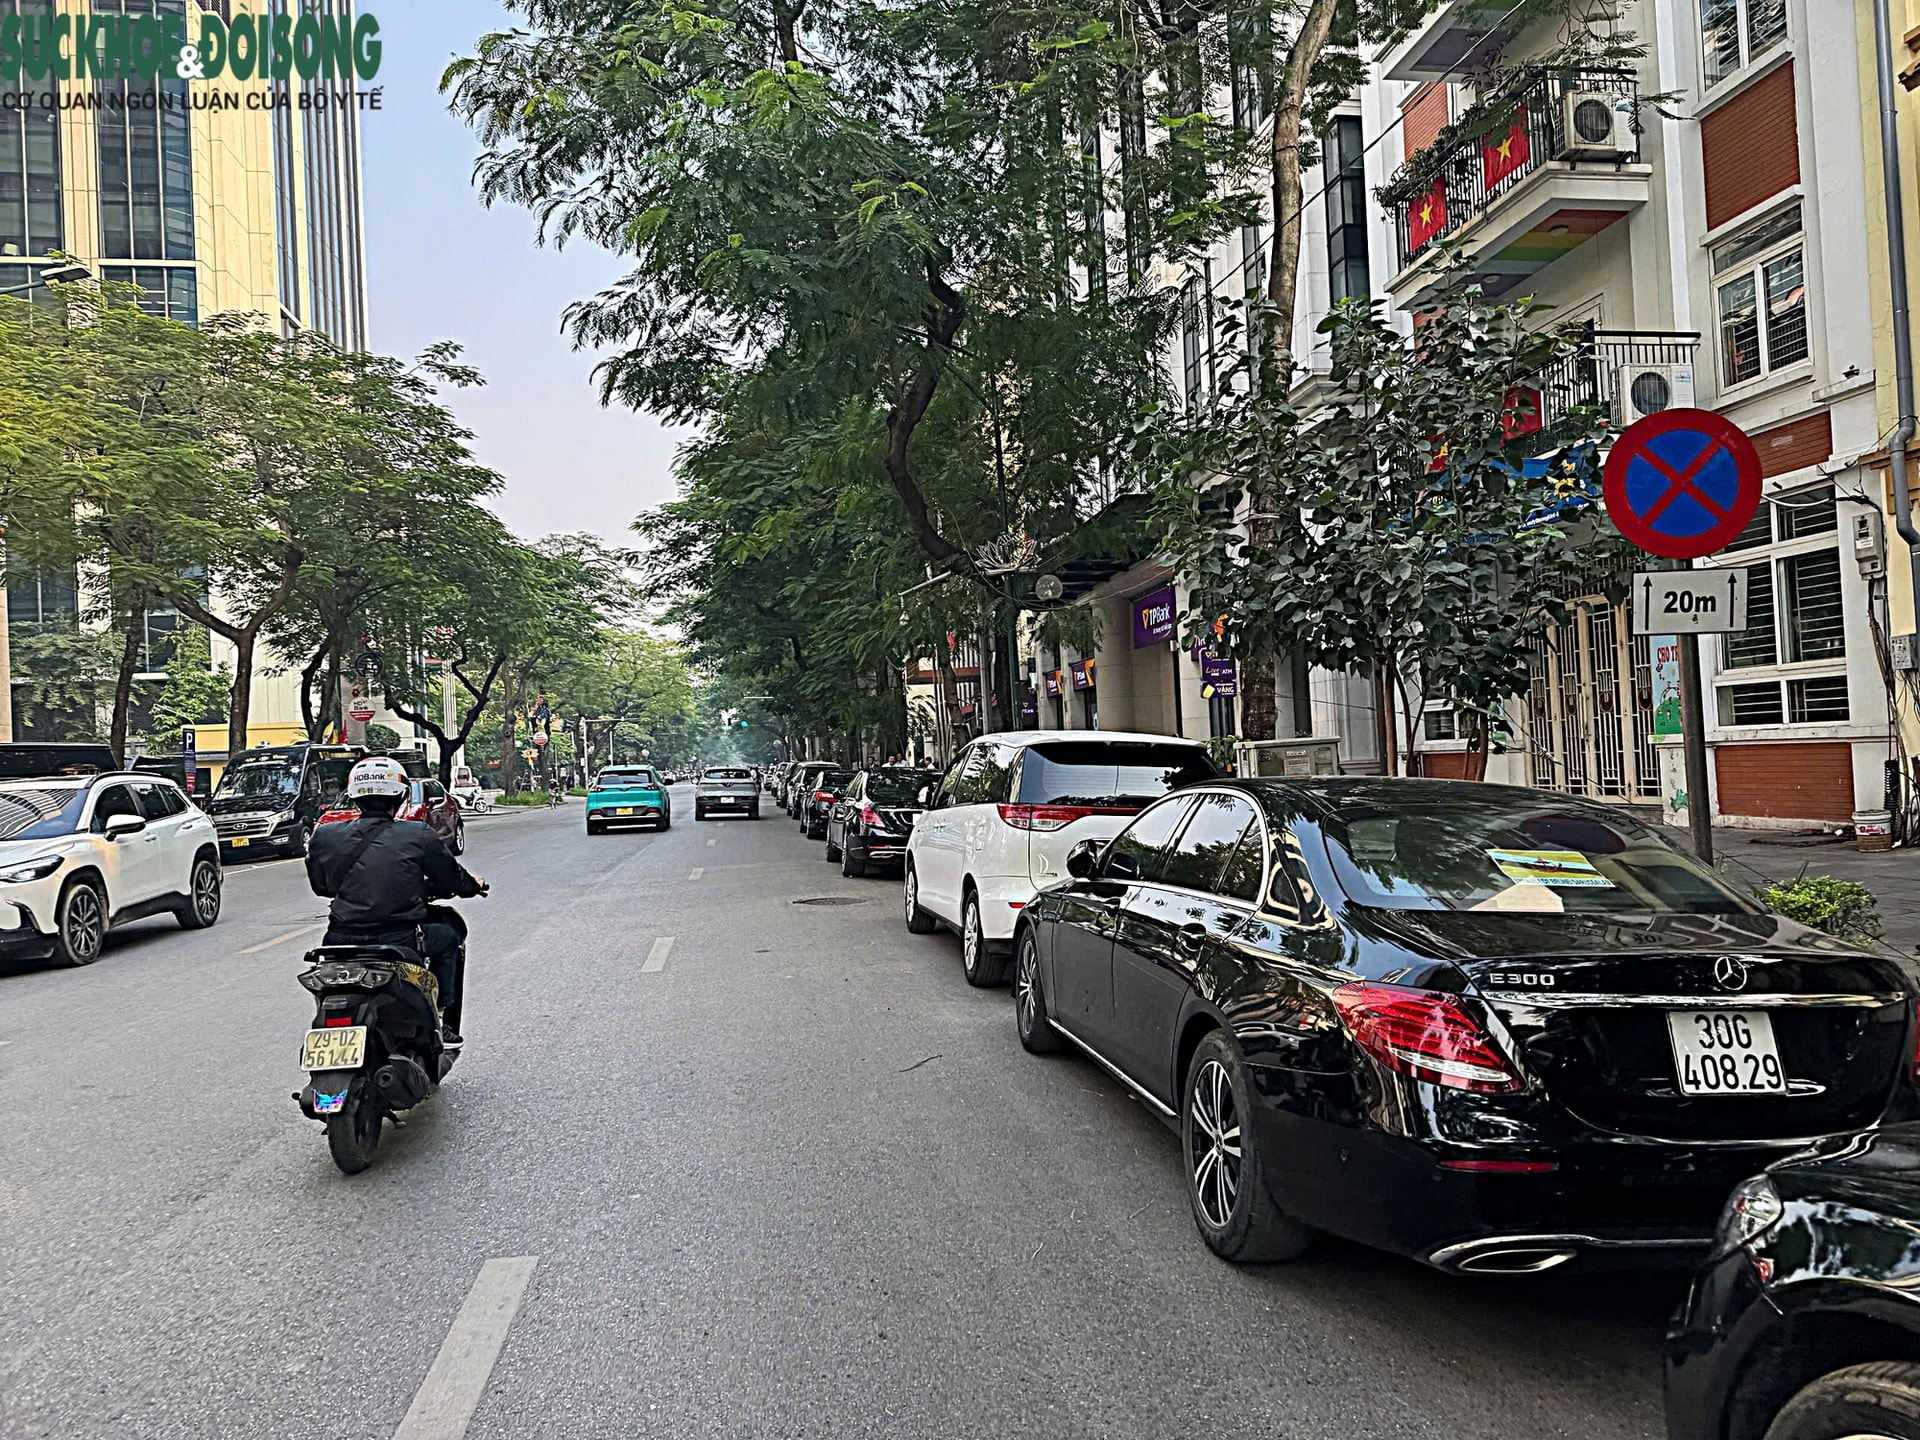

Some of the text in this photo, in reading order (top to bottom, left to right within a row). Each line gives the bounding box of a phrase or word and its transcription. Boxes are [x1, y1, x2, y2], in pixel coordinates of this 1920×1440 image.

[1663, 590, 1716, 613] 20m
[186, 732, 193, 747] P
[354, 773, 385, 782] HDBank
[1694, 1014, 1752, 1049] 30G
[1685, 1053, 1782, 1091] 408.29
